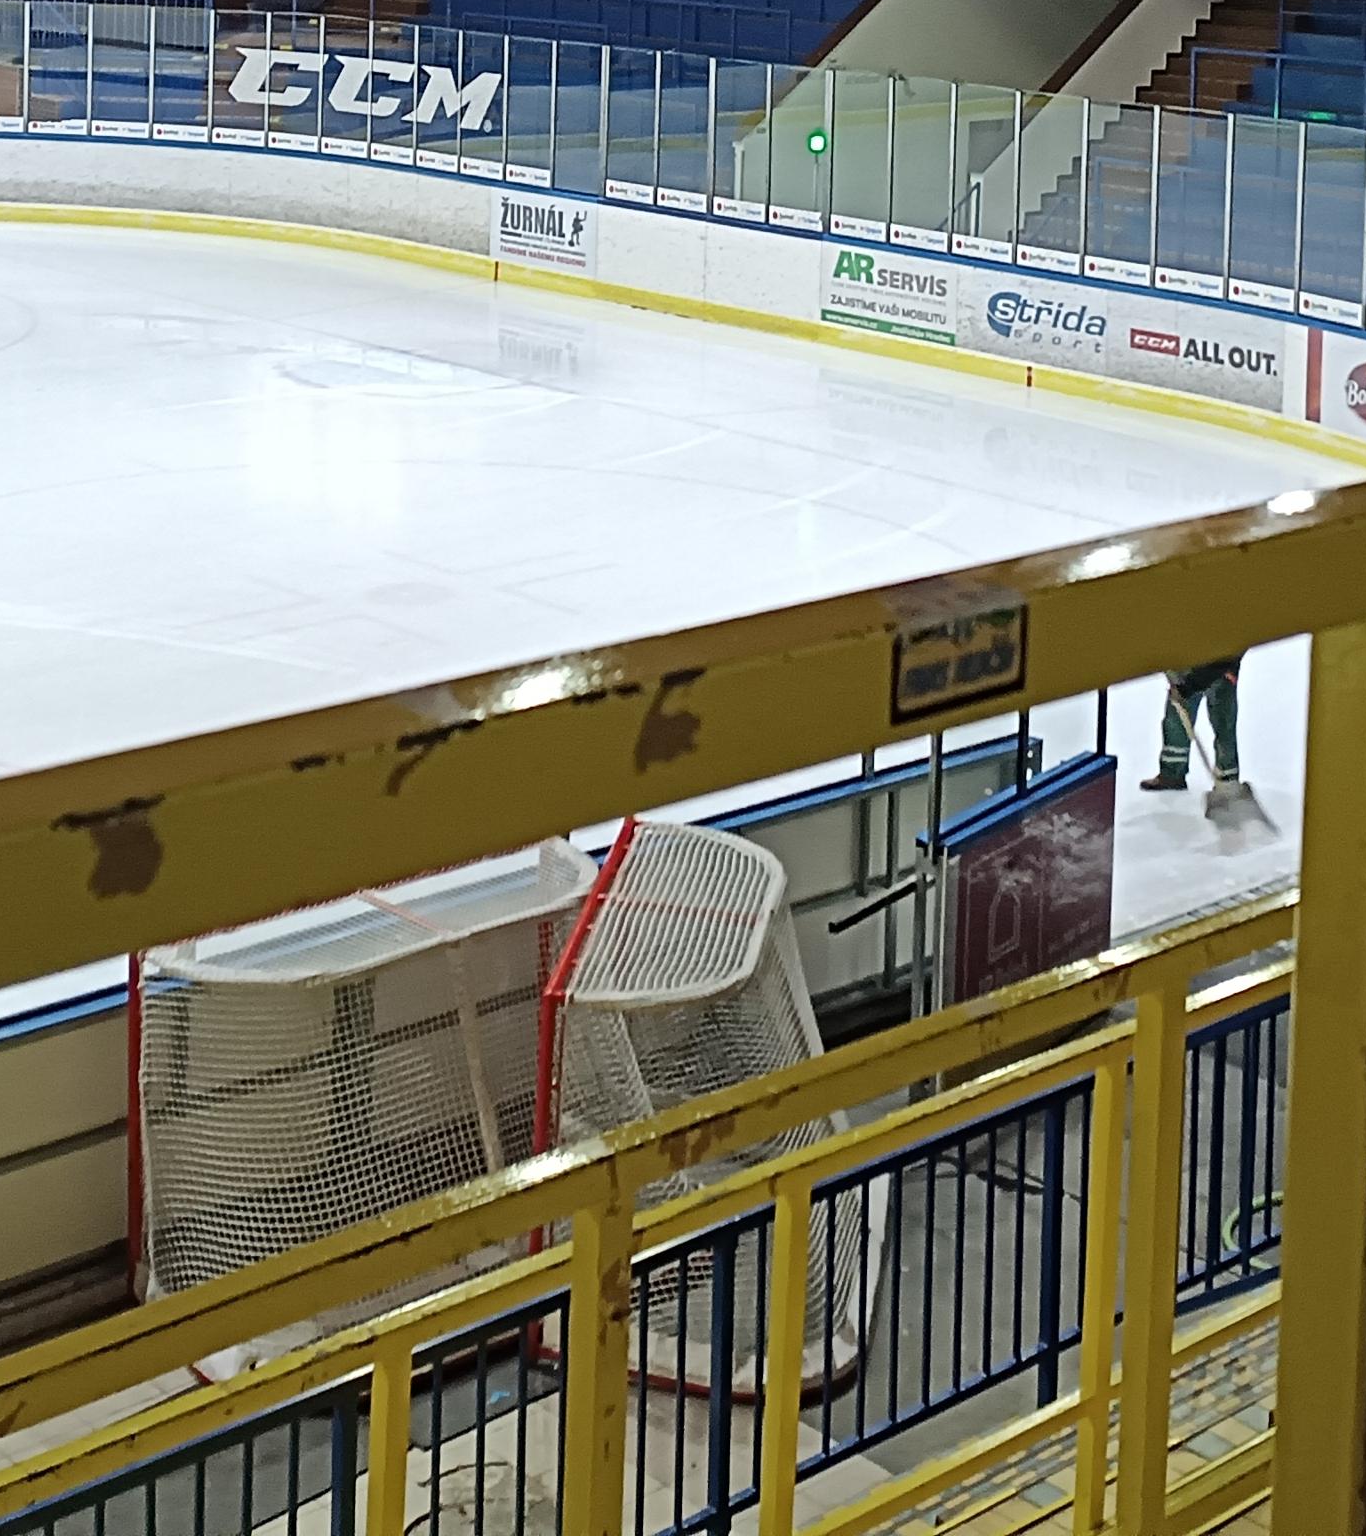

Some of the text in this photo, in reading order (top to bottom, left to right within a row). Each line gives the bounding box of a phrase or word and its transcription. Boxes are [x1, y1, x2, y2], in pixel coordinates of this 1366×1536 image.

[227, 46, 502, 131] CCM
[500, 196, 566, 239] ŽURNÁL
[833, 250, 874, 284] AR
[901, 307, 947, 325] MOBILITU
[1133, 334, 1278, 377] CCM ALL OUT.
